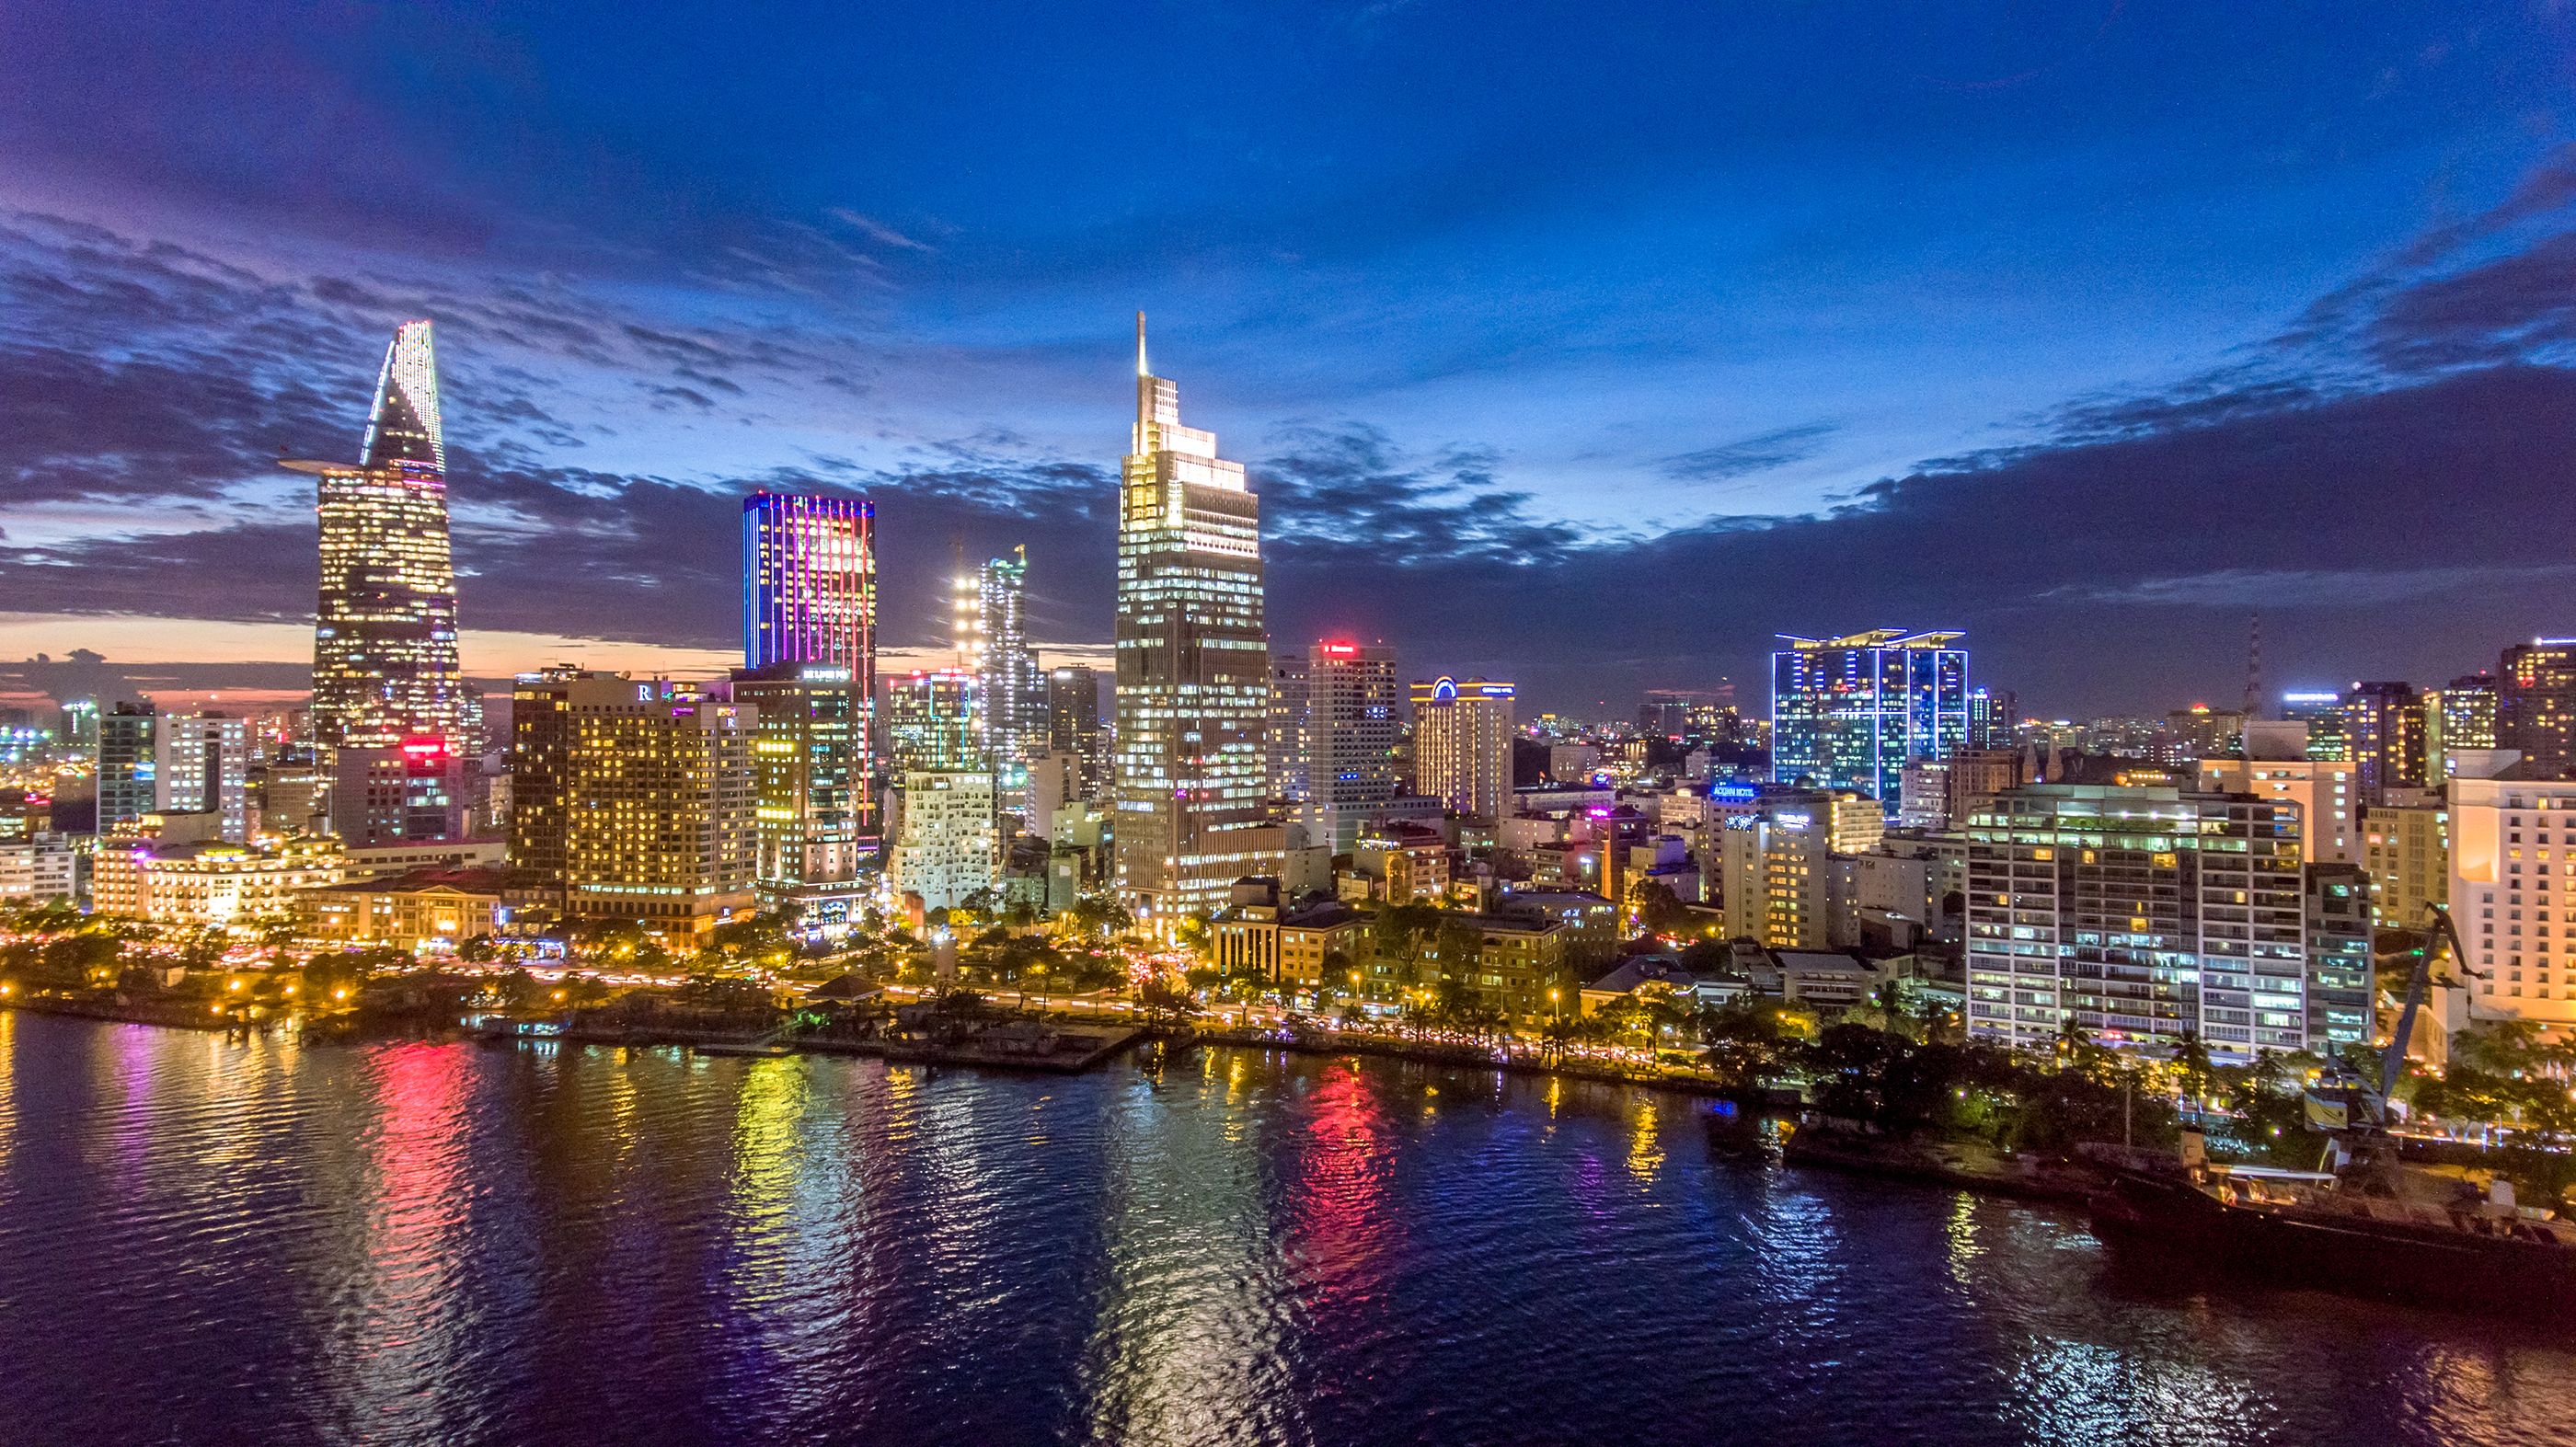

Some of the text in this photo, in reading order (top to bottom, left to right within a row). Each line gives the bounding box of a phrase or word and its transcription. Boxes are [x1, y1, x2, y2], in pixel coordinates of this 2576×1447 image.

[638, 684, 652, 701] R
[727, 718, 735, 728] R
[723, 908, 730, 916] R
